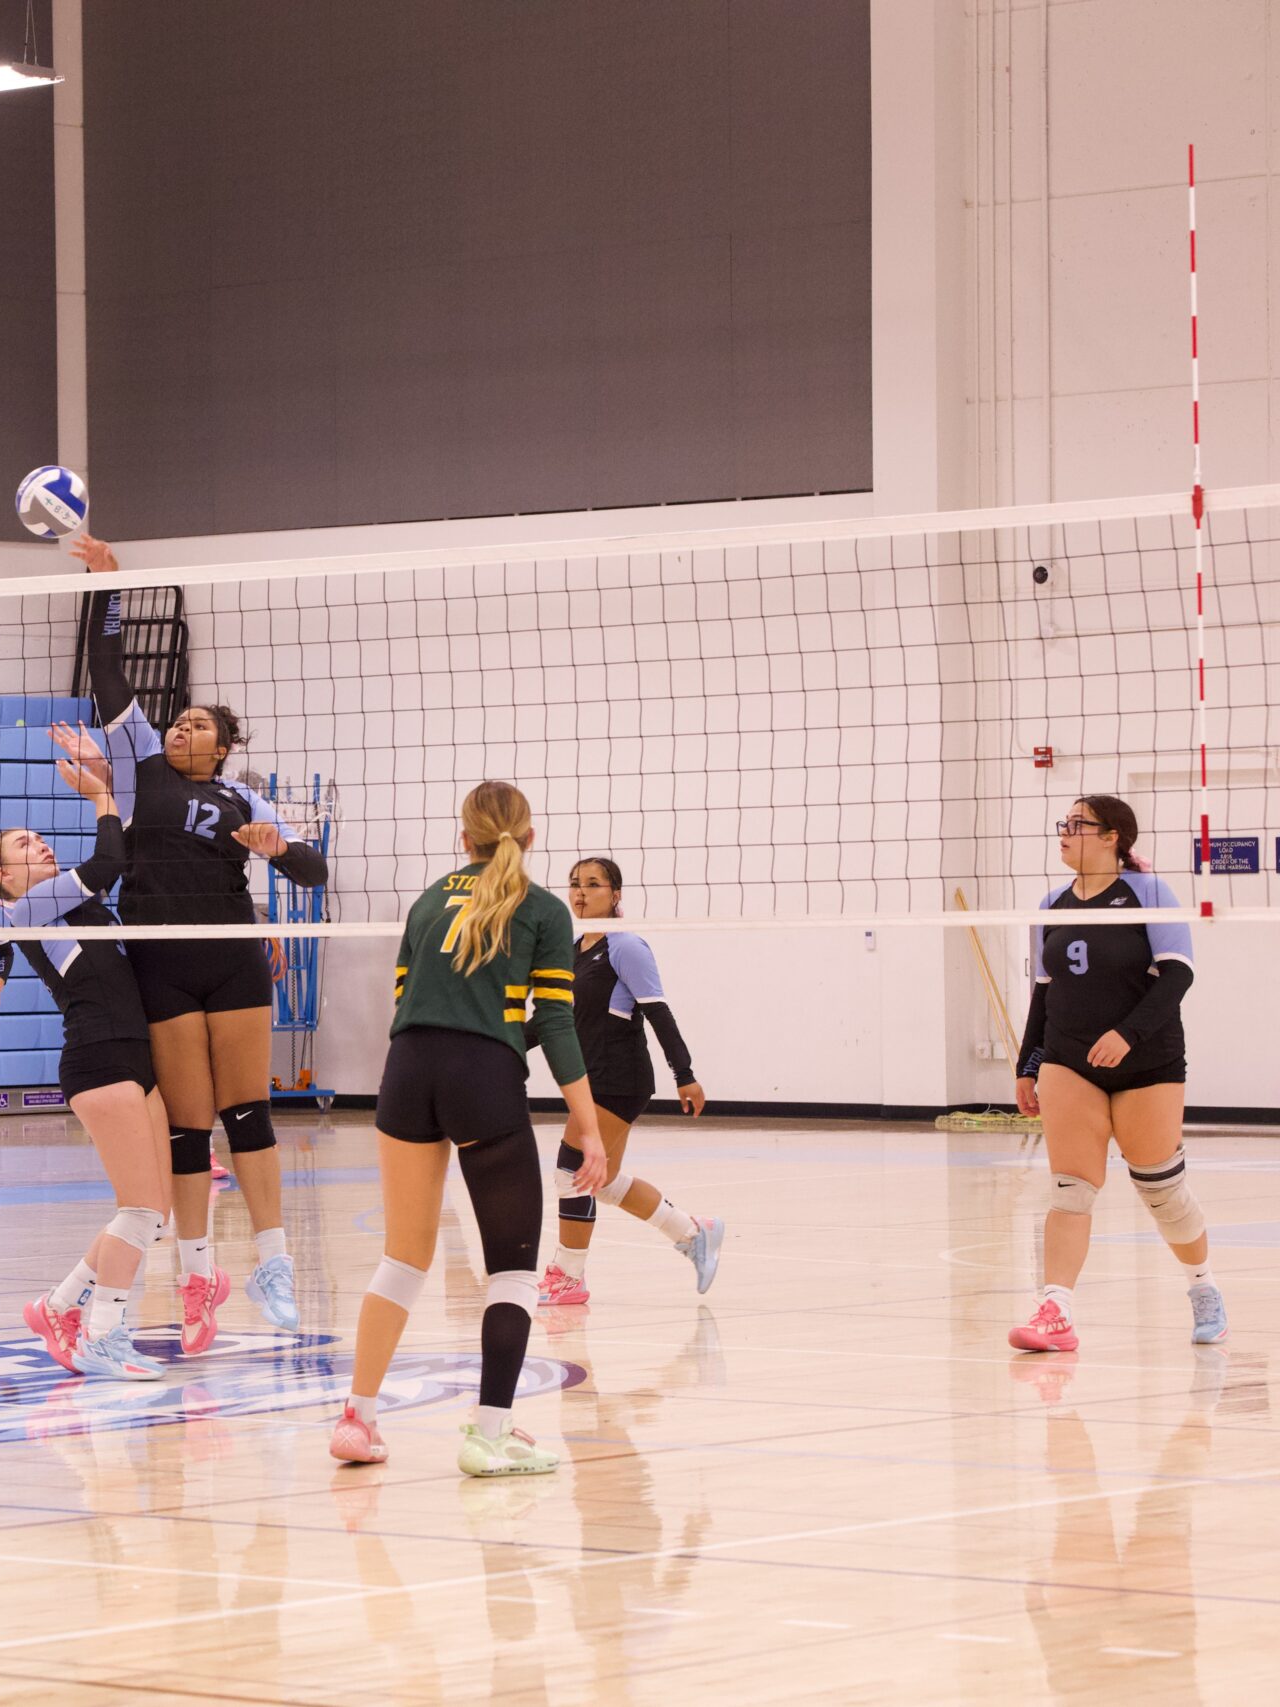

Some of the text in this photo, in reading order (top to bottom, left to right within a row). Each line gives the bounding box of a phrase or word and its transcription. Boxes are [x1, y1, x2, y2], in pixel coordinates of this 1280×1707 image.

[184, 799, 221, 840] 12
[443, 875, 479, 891] STO
[440, 896, 474, 953] 7
[1067, 940, 1089, 975] 9
